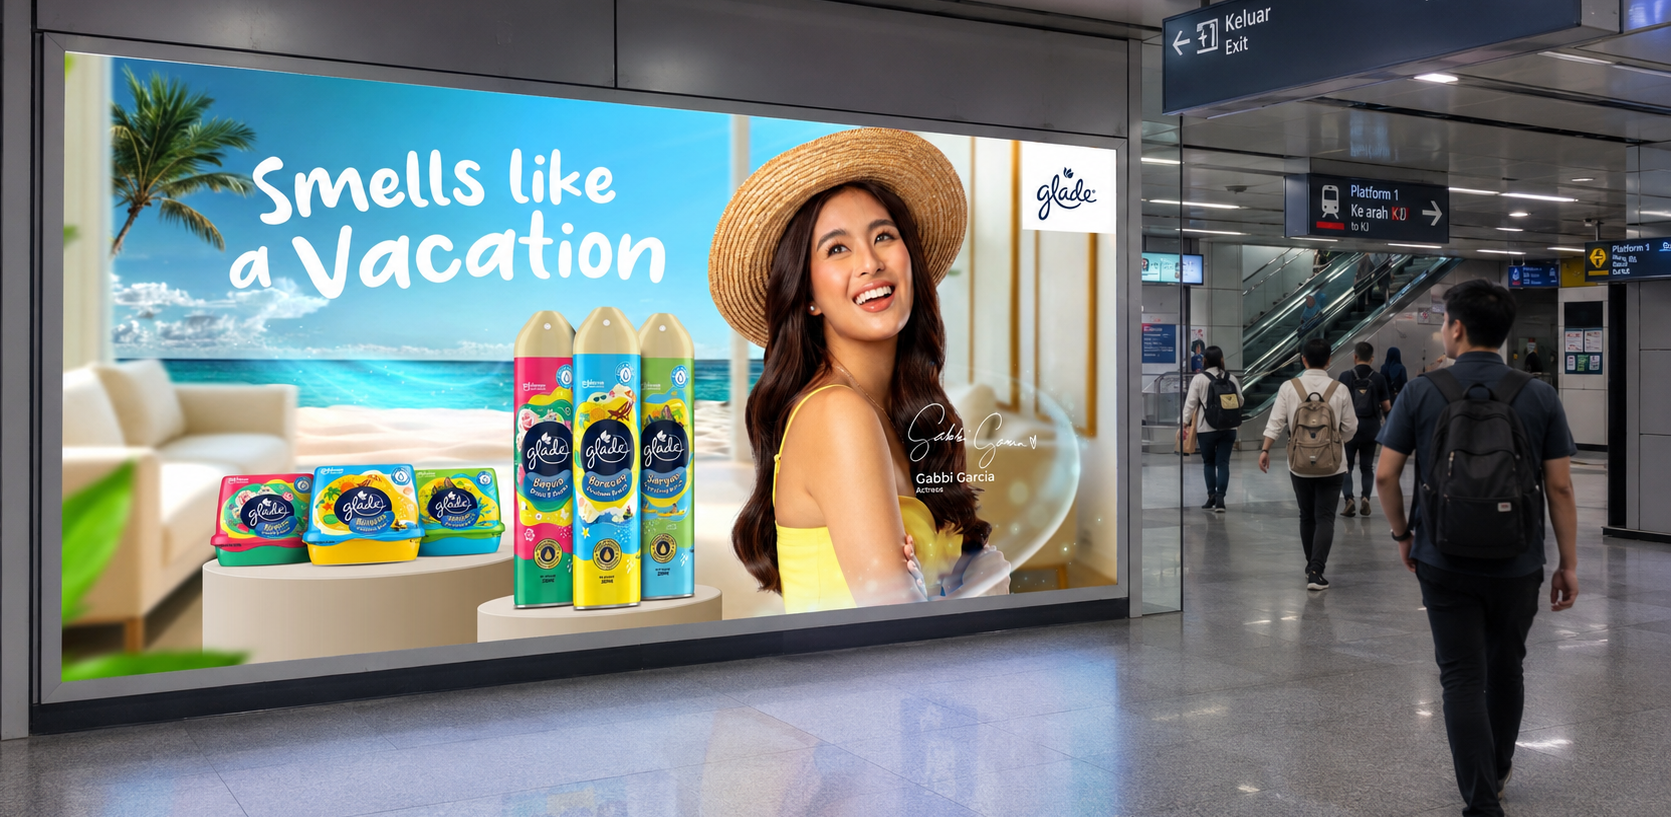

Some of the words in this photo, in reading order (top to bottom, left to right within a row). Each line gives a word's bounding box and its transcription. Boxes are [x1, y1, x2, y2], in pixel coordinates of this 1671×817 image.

[1225, 7, 1271, 32] Keluar
[1225, 36, 1249, 55] Exit
[252, 148, 485, 225] Smells
[509, 148, 616, 204] like
[1037, 174, 1097, 220] glade
[1351, 185, 1391, 200] Platform
[1394, 189, 1399, 201] 1
[1351, 204, 1364, 217] Ke
[1366, 205, 1388, 220] arah
[1351, 222, 1359, 231] to
[229, 245, 272, 289] a
[292, 210, 666, 299] Vacation
[1612, 244, 1644, 253] Platform
[1645, 243, 1650, 251] 1
[527, 435, 571, 470] glade
[585, 434, 631, 469] glade
[644, 434, 684, 467] glade
[916, 472, 953, 484] Gabbi
[956, 471, 995, 483] Garcia
[343, 494, 387, 522] glade
